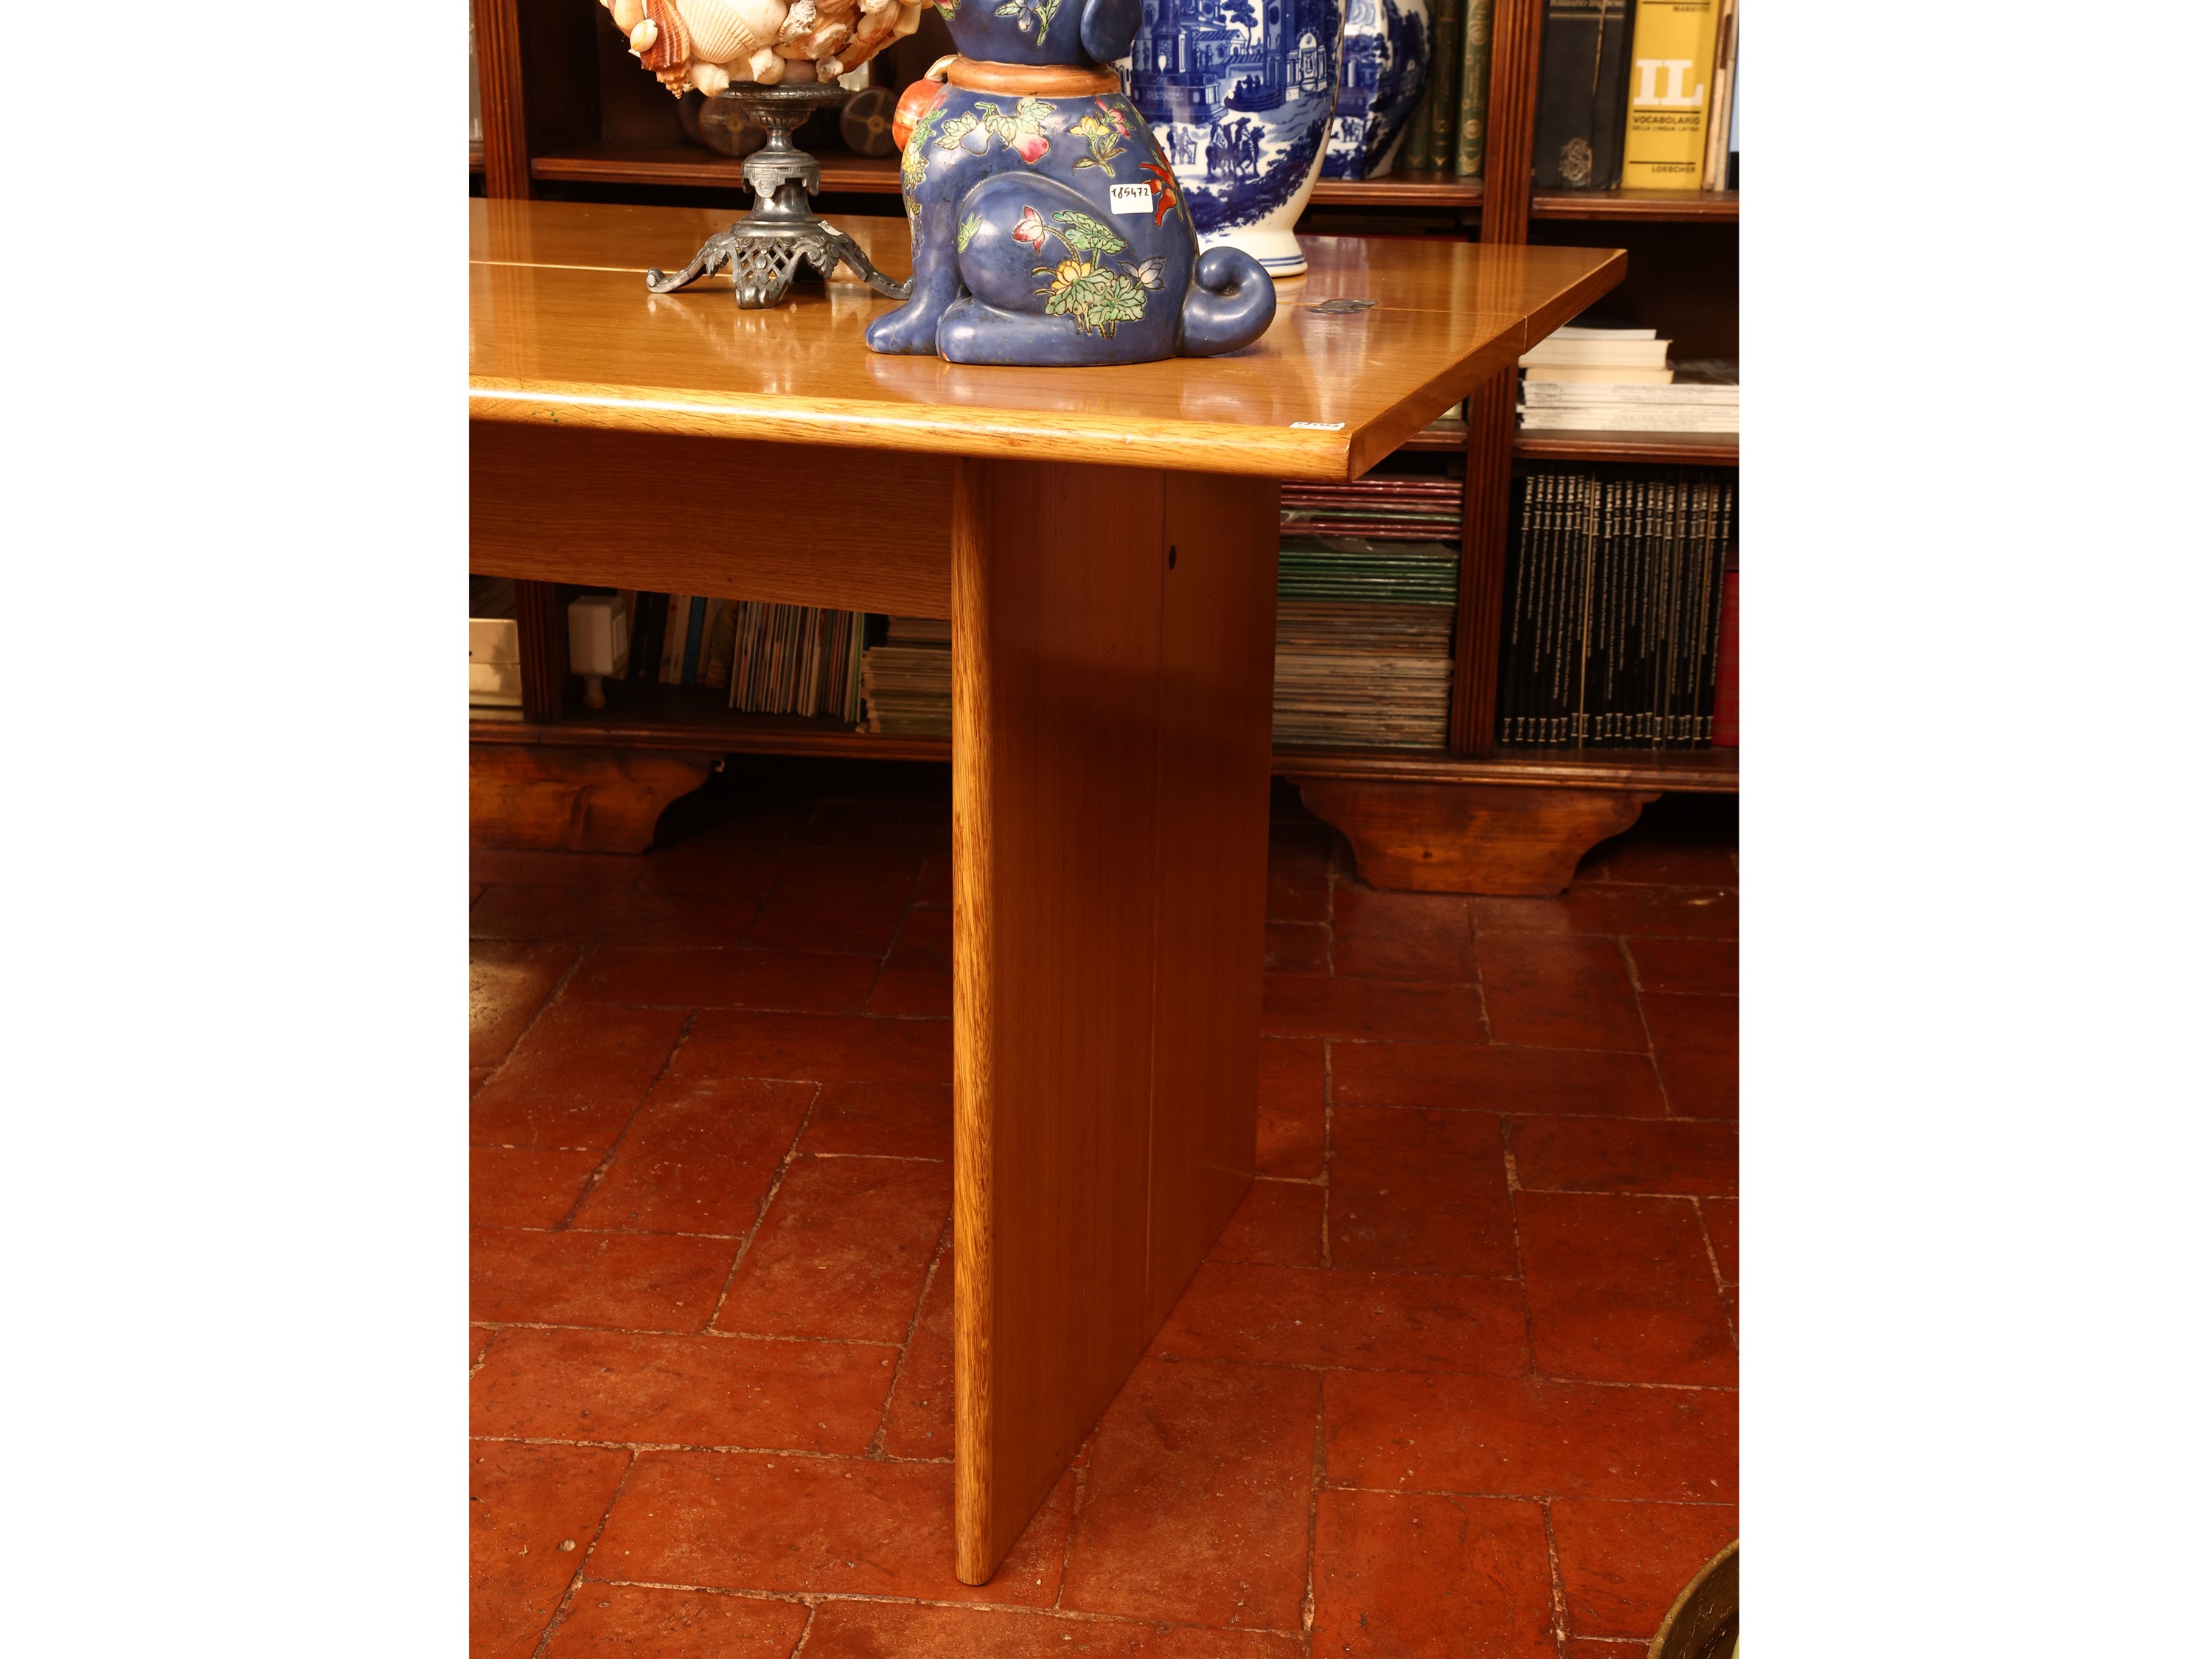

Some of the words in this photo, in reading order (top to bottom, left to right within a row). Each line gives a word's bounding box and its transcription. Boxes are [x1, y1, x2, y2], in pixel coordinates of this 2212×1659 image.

[1632, 58, 1704, 106] IL
[1632, 115, 1700, 125] VOCABOLARIO
[1111, 187, 1149, 199] 185472
